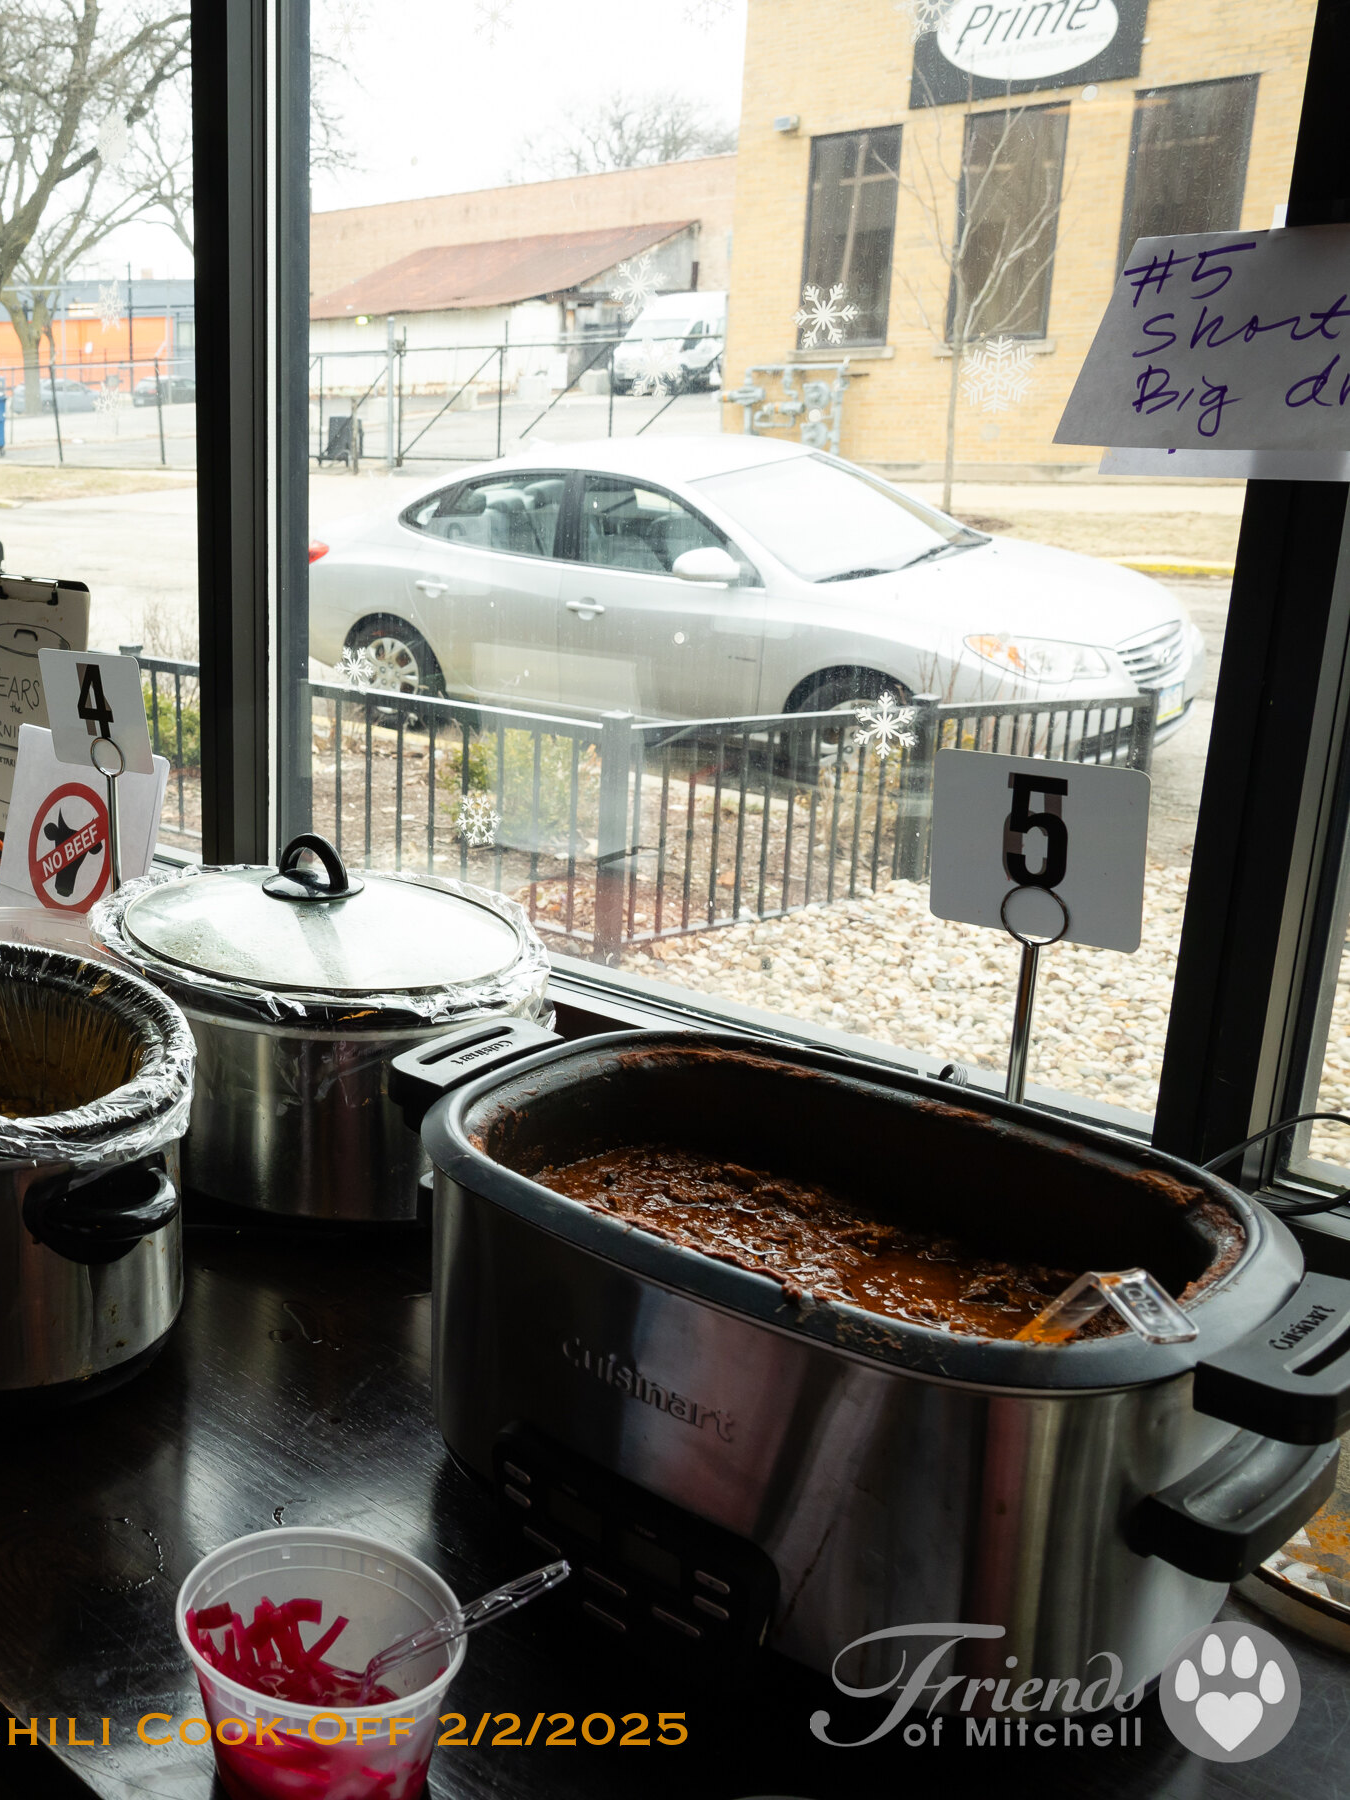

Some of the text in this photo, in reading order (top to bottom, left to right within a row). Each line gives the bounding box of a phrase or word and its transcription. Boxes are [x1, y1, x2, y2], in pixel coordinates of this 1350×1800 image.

[954, 0, 1100, 56] Prime
[1124, 242, 1257, 308] #5
[1132, 364, 1243, 438] Big
[9, 701, 23, 714] the
[77, 663, 115, 739] 4
[42, 823, 98, 878] NO BEEF
[1004, 771, 1069, 889] 5
[450, 1040, 513, 1065] Cuisinart
[1269, 1305, 1336, 1350] Cuisinart
[562, 1336, 735, 1443] Cuisinart
